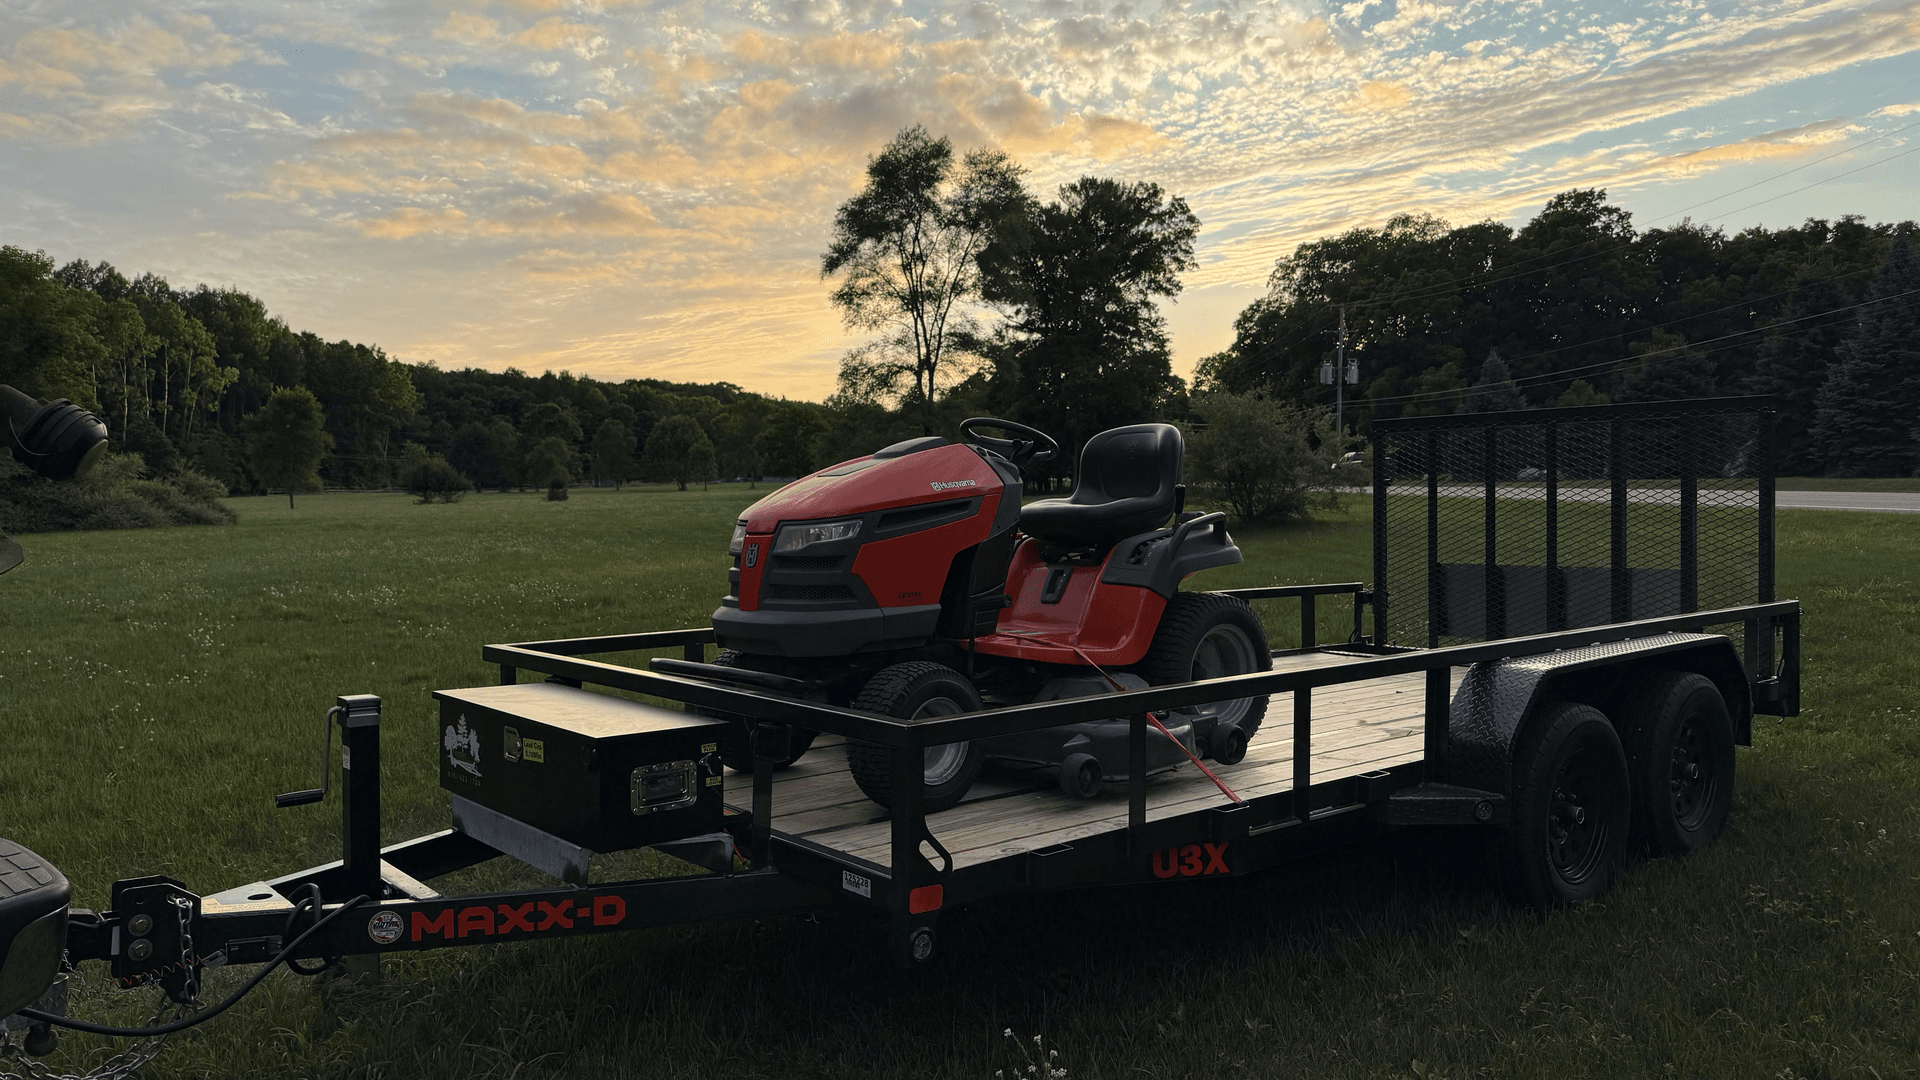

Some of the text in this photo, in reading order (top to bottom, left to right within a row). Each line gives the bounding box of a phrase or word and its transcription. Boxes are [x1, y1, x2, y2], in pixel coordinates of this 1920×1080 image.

[940, 479, 976, 490] Husqvarna
[1152, 841, 1230, 879] U3X
[844, 872, 869, 888] 125228
[411, 895, 625, 942] MAXX-D
